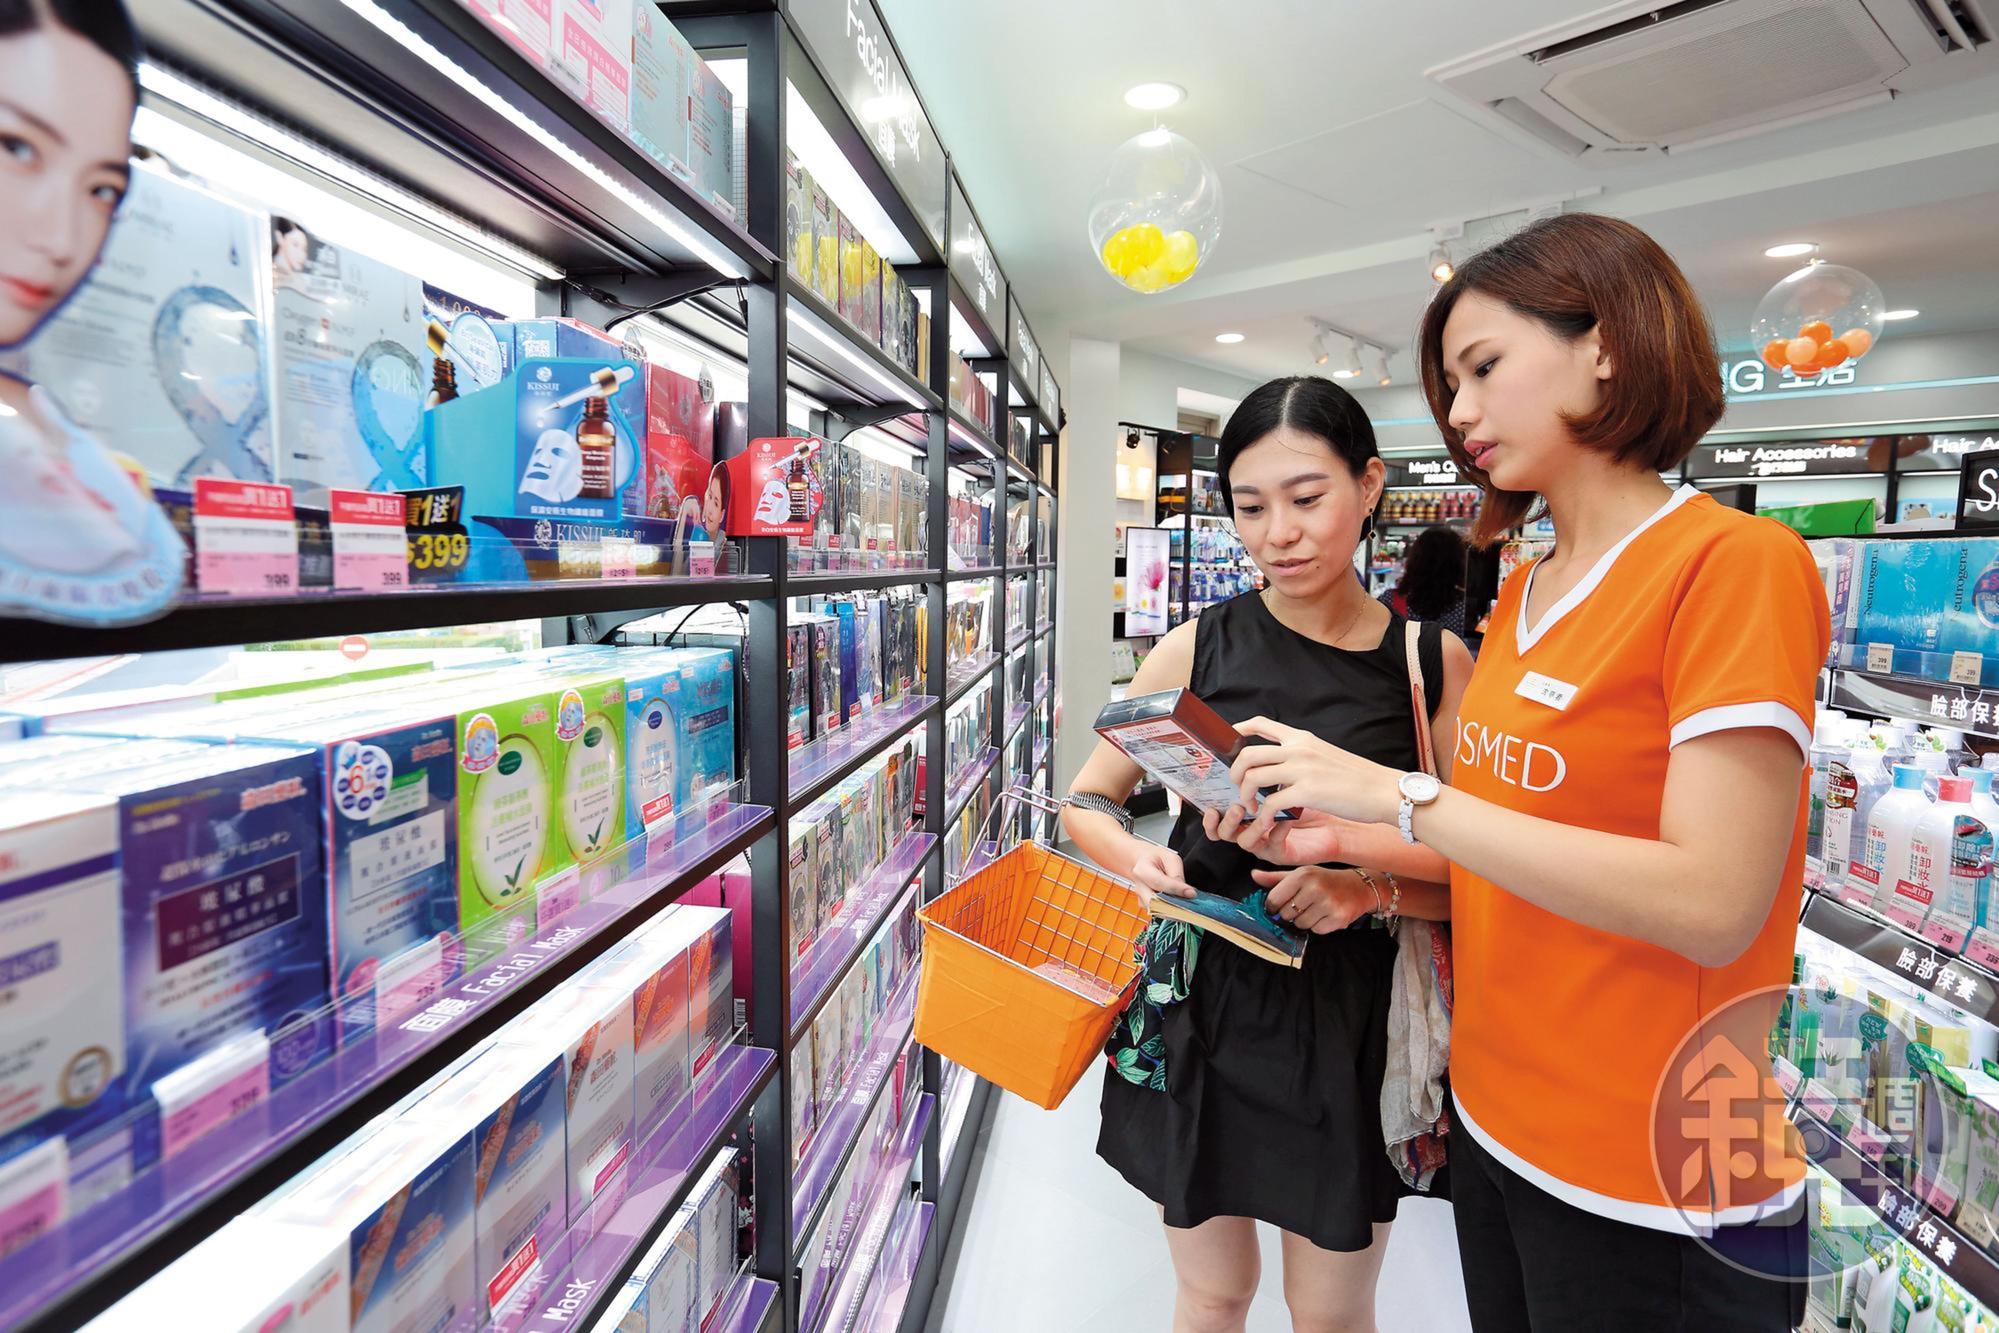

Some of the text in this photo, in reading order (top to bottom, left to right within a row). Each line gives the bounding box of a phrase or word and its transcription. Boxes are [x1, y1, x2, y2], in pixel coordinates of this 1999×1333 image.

[1715, 444, 1857, 463] Hair Accessories
[1863, 550, 1879, 615] Neutrogena
[1952, 548, 1968, 614] eutrogena
[1454, 715, 1566, 792] SMED
[461, 953, 544, 995] Facial
[530, 925, 587, 950] Mask
[1896, 947, 1979, 1003] 臉部保養
[542, 1278, 597, 1322] Mask
